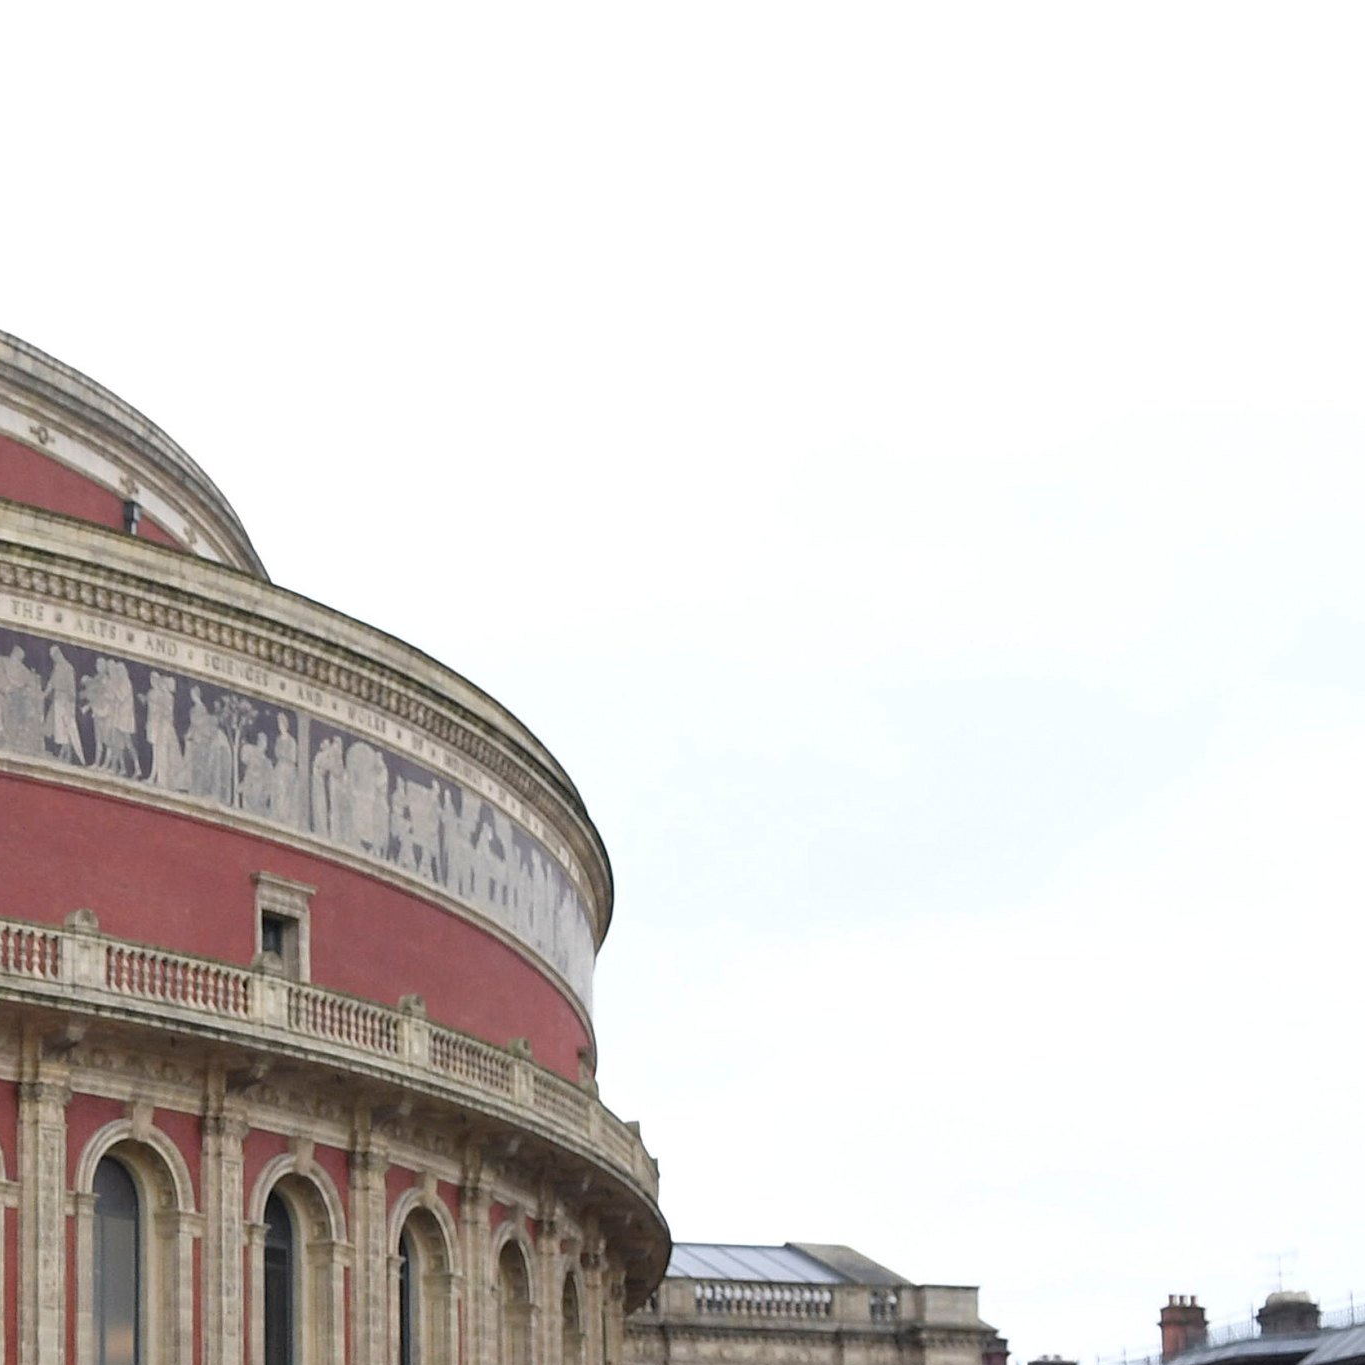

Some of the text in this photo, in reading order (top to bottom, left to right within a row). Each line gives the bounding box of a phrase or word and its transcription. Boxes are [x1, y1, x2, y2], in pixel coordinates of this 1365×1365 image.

[12, 600, 45, 622] THE
[74, 618, 117, 640] ARTS
[145, 635, 178, 657] AND
